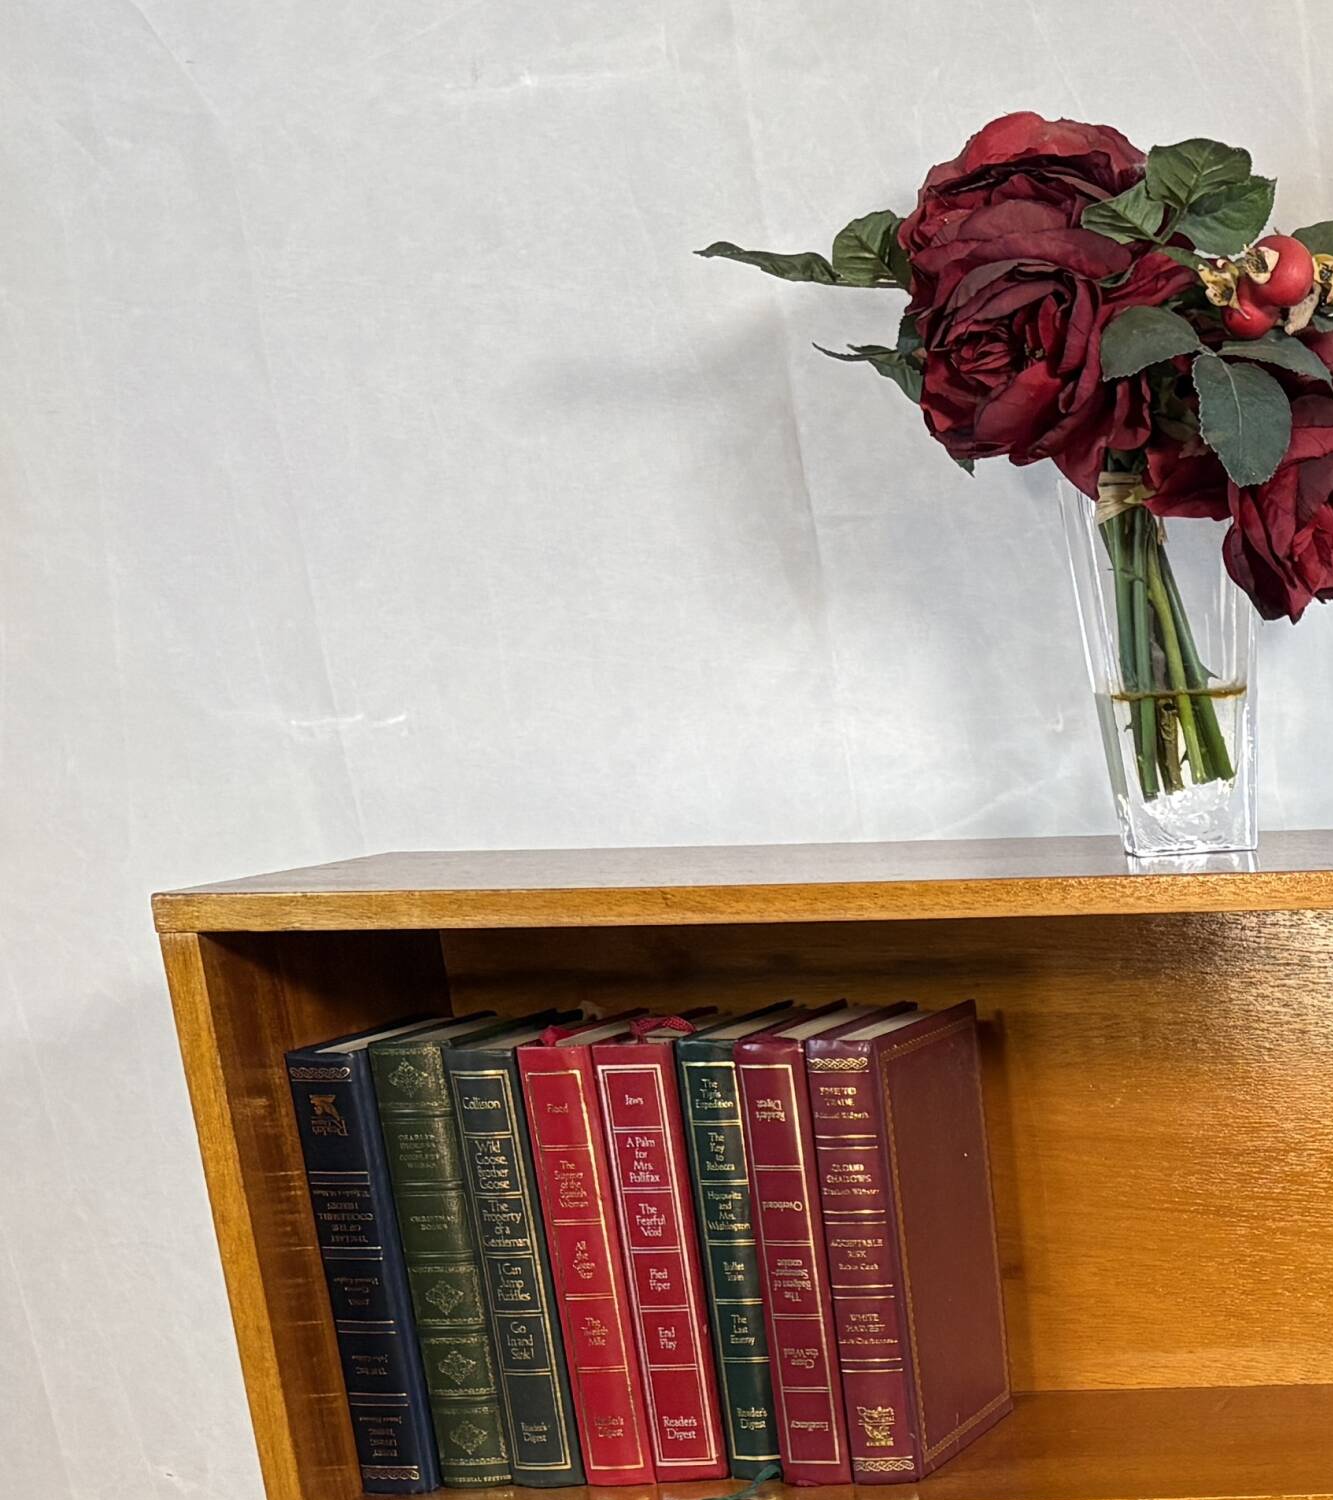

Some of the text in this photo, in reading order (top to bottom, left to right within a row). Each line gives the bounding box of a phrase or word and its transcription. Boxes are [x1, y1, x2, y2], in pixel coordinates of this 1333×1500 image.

[702, 1079, 718, 1089] The
[463, 1097, 501, 1110] Collision
[625, 1094, 644, 1106] Jaws
[626, 1136, 656, 1148] A Palm
[708, 1133, 725, 1142] The
[475, 1140, 501, 1154] Wild
[636, 1150, 648, 1159] for
[716, 1154, 725, 1162] to
[560, 1160, 575, 1170] The
[629, 1171, 661, 1183] Pollifax
[480, 1179, 510, 1190] Goose
[488, 1200, 509, 1210] The
[639, 1204, 657, 1214] The
[719, 1201, 732, 1210] and
[761, 1200, 803, 1212] Overboard
[636, 1214, 666, 1226] Fearful
[640, 1226, 662, 1238] Void
[576, 1241, 586, 1251] All
[503, 1263, 522, 1276] Can
[650, 1268, 668, 1280] Pied
[784, 1291, 801, 1302] The
[584, 1317, 601, 1326] The
[731, 1314, 747, 1324] The
[510, 1321, 527, 1333] Go
[658, 1327, 676, 1338] End
[660, 1338, 677, 1350] Play
[736, 1407, 768, 1418] Reader's
[663, 1415, 697, 1428] Reader's
[739, 1418, 766, 1431] Digest
[523, 1432, 547, 1444] Digest
[667, 1428, 697, 1441] Digest
